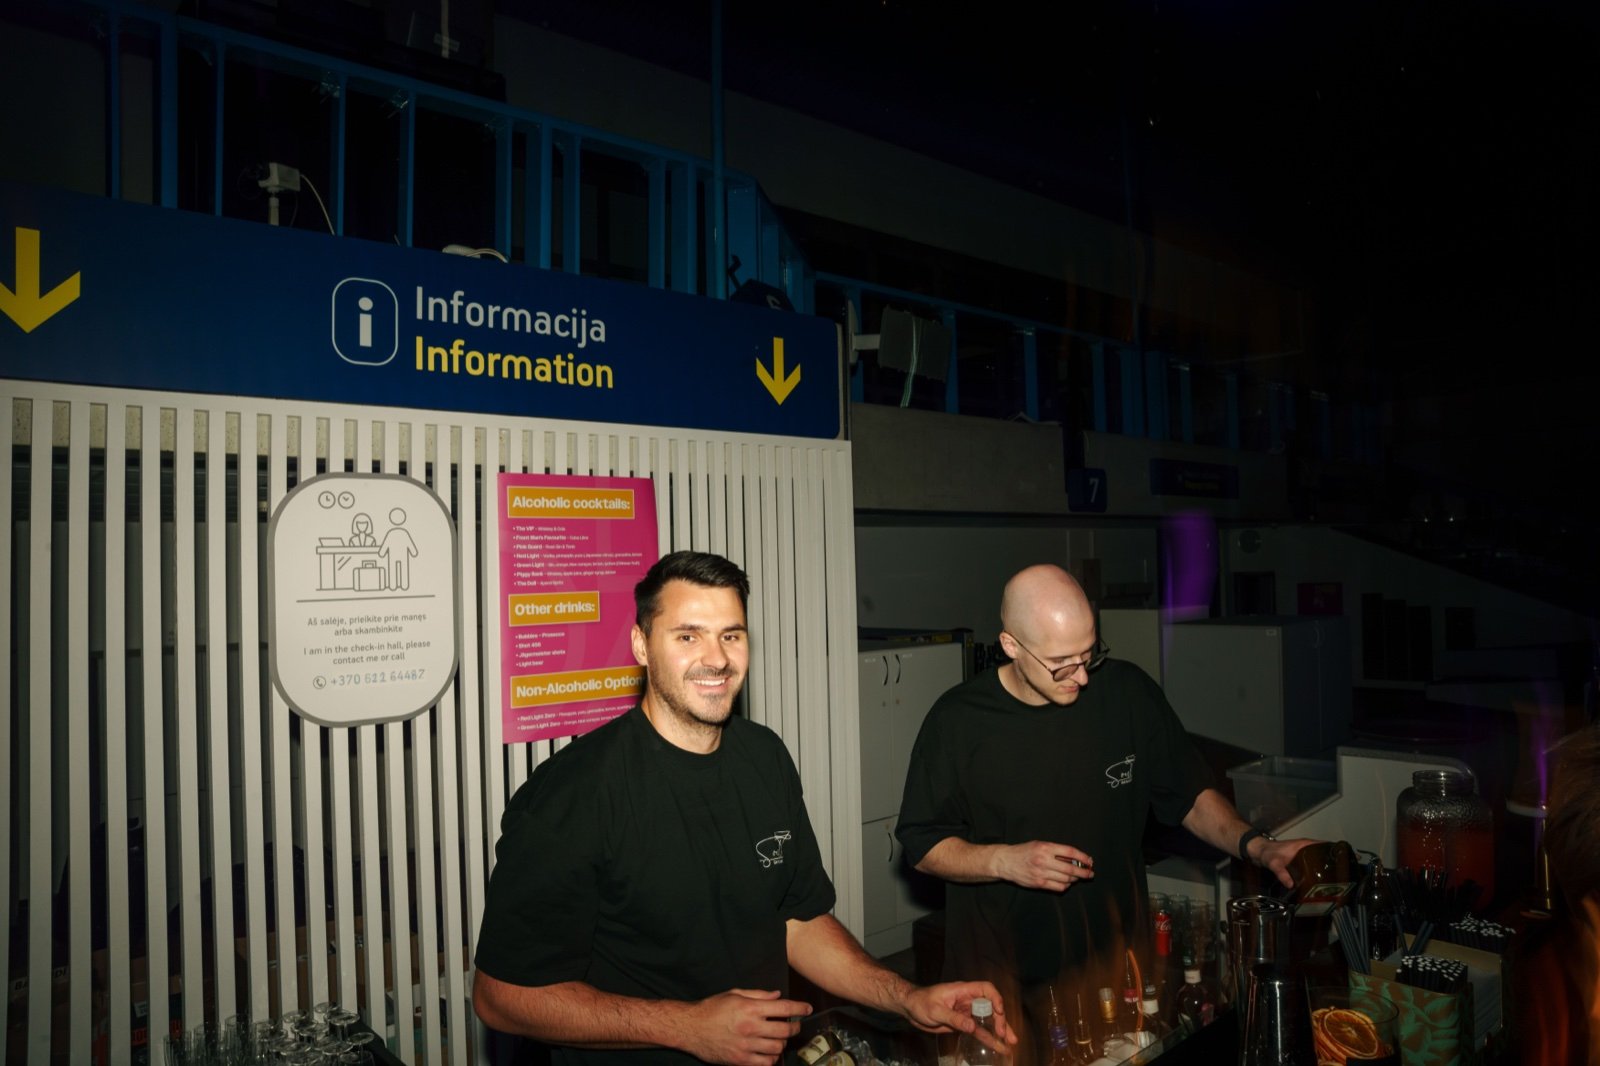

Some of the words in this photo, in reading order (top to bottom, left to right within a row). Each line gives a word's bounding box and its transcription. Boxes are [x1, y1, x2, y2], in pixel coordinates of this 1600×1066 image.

[415, 286, 606, 348] Informacija
[415, 336, 614, 389] Information
[1088, 476, 1100, 504] 7
[512, 495, 571, 509] Alcoholic
[573, 497, 631, 511] cocktails:
[514, 603, 552, 616] Other
[554, 602, 595, 614] drinks:
[384, 614, 399, 624] prie
[334, 627, 352, 636] arba
[324, 646, 332, 655] in
[335, 645, 348, 654] the
[350, 642, 385, 652] check-in
[406, 640, 431, 651] please
[332, 656, 364, 665] contact
[366, 655, 379, 663] me
[381, 654, 389, 662] or
[391, 652, 405, 661] call
[330, 674, 361, 686] +370
[516, 677, 603, 699] Non-Alcoholic
[604, 676, 645, 691] Option
